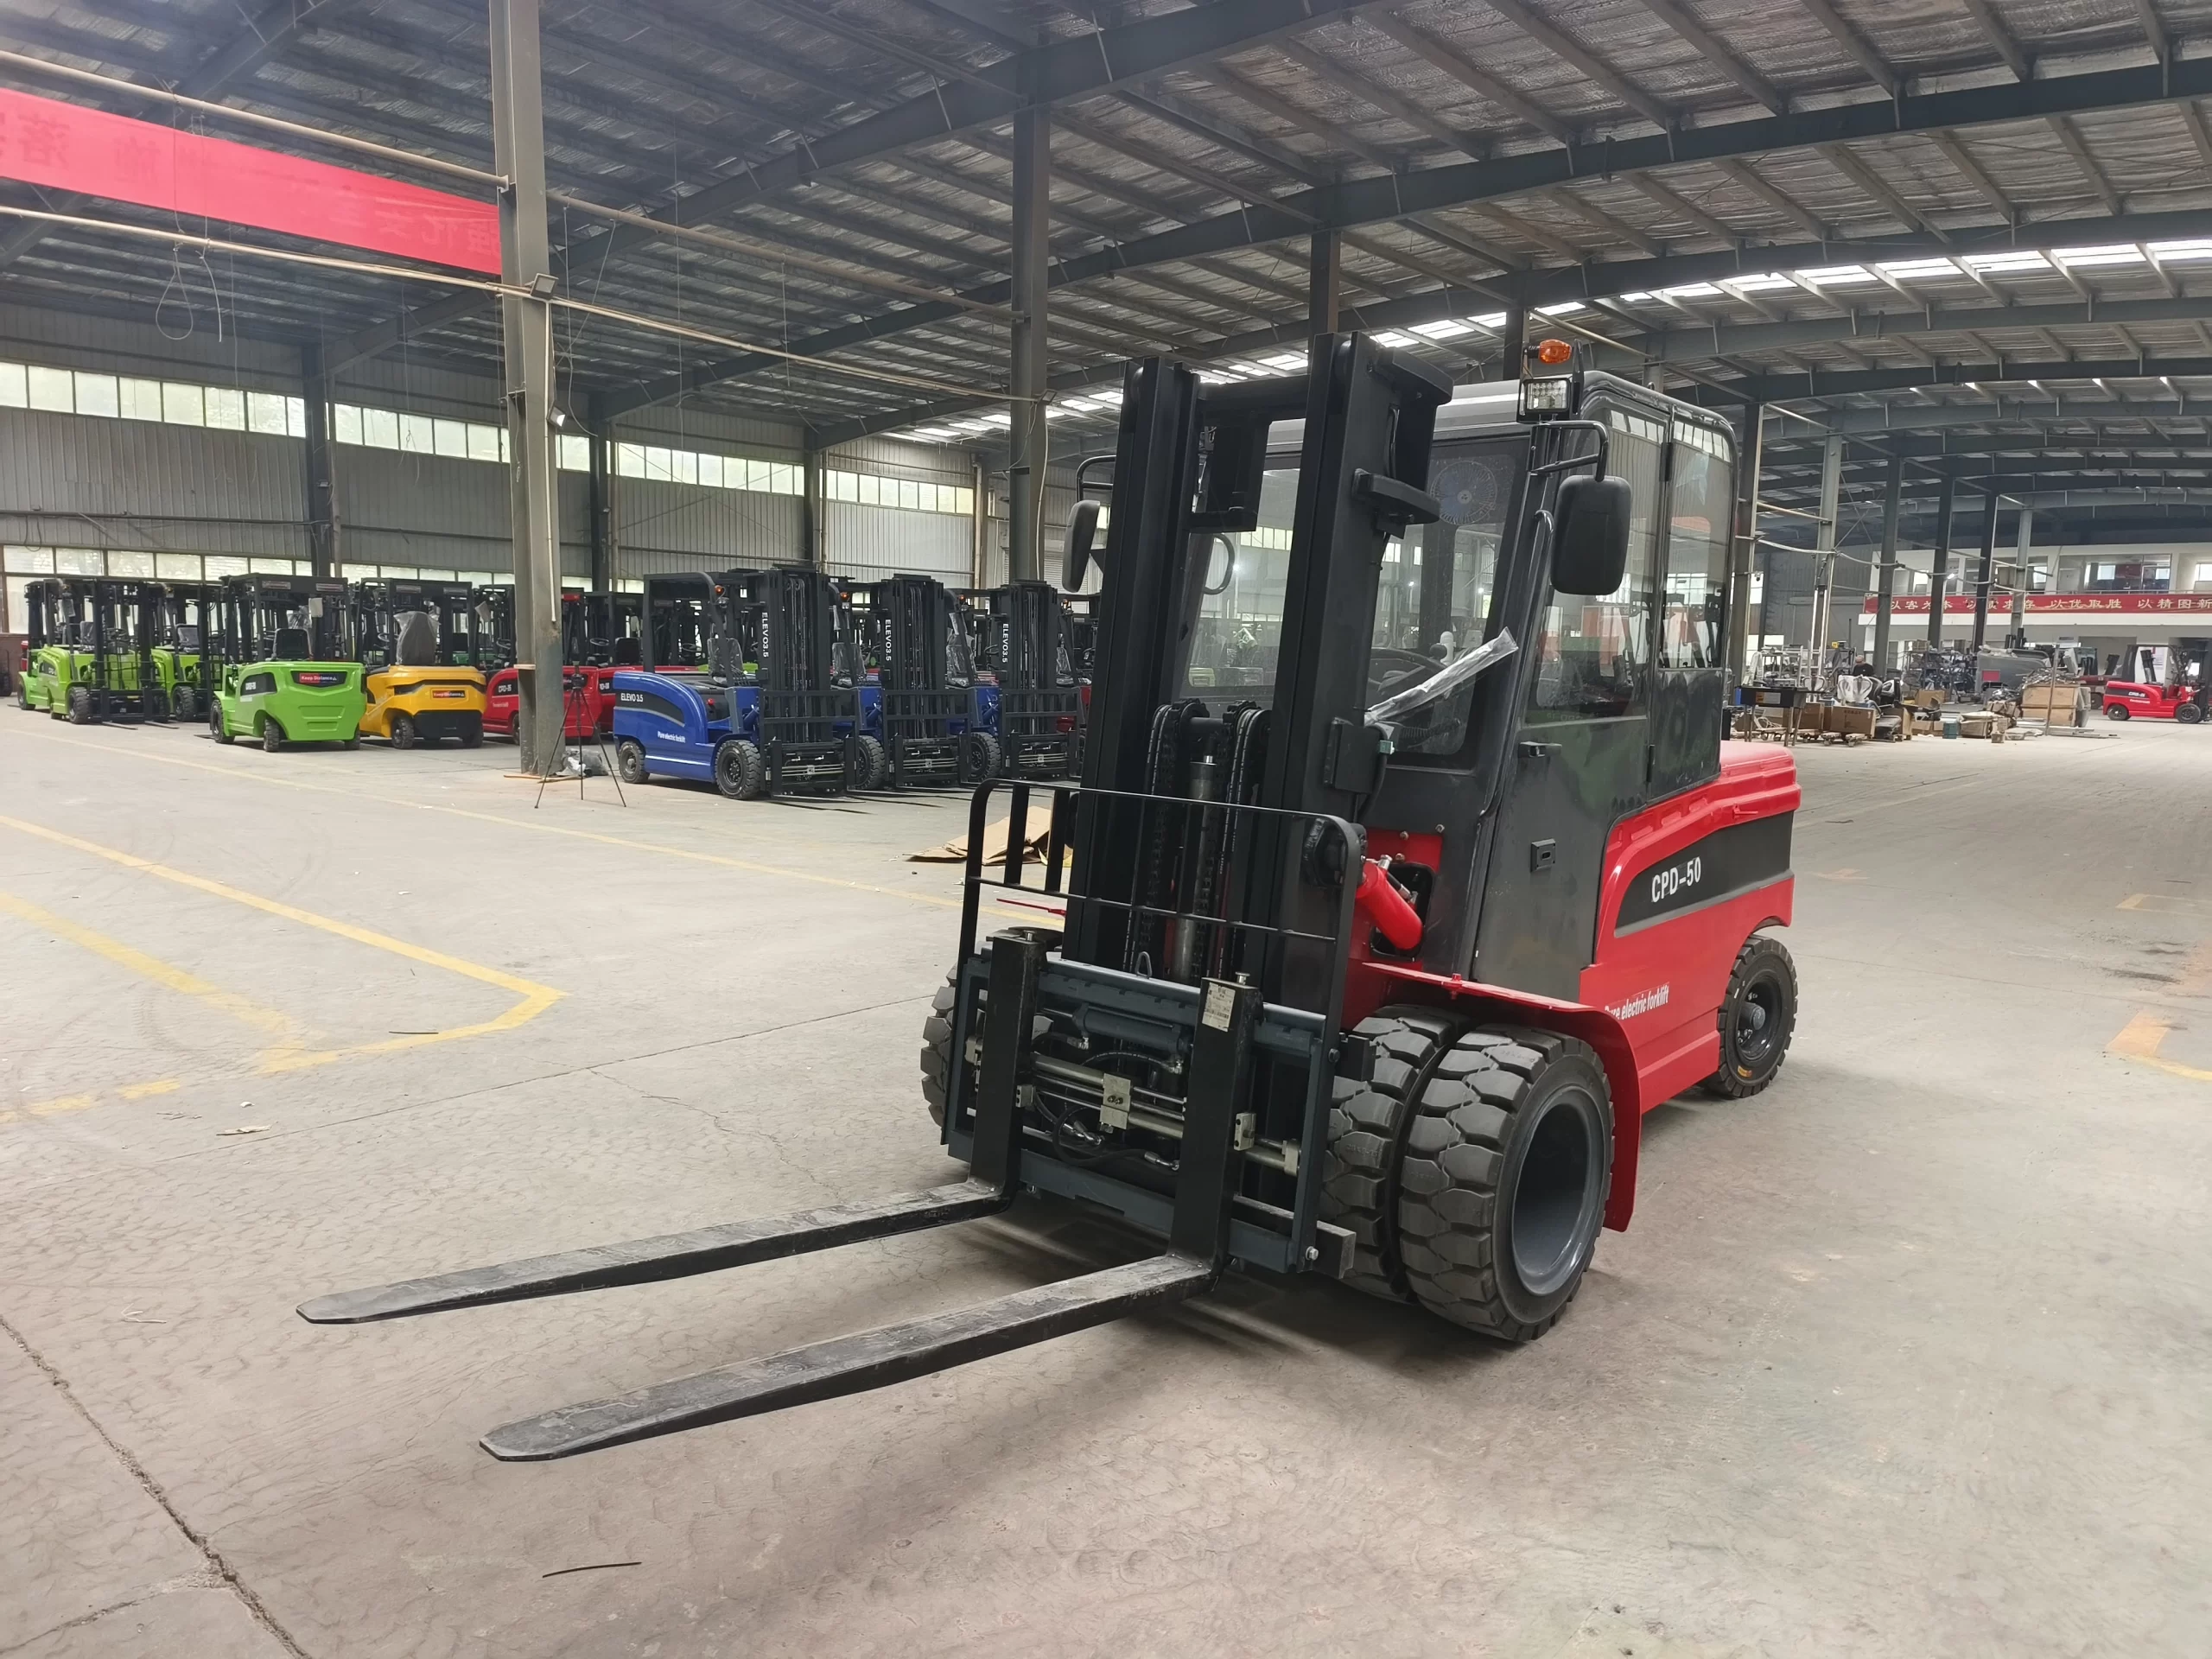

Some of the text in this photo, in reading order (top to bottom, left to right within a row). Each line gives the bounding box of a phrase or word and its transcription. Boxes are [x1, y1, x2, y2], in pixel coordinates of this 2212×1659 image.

[2050, 599, 2122, 609] 以优取胜
[2138, 599, 2212, 609] 以精图新
[620, 692, 637, 702] ELEVO
[1651, 856, 1701, 903] CPD-50
[1621, 993, 1647, 1020] electric
[1647, 984, 1669, 1012] forklift
